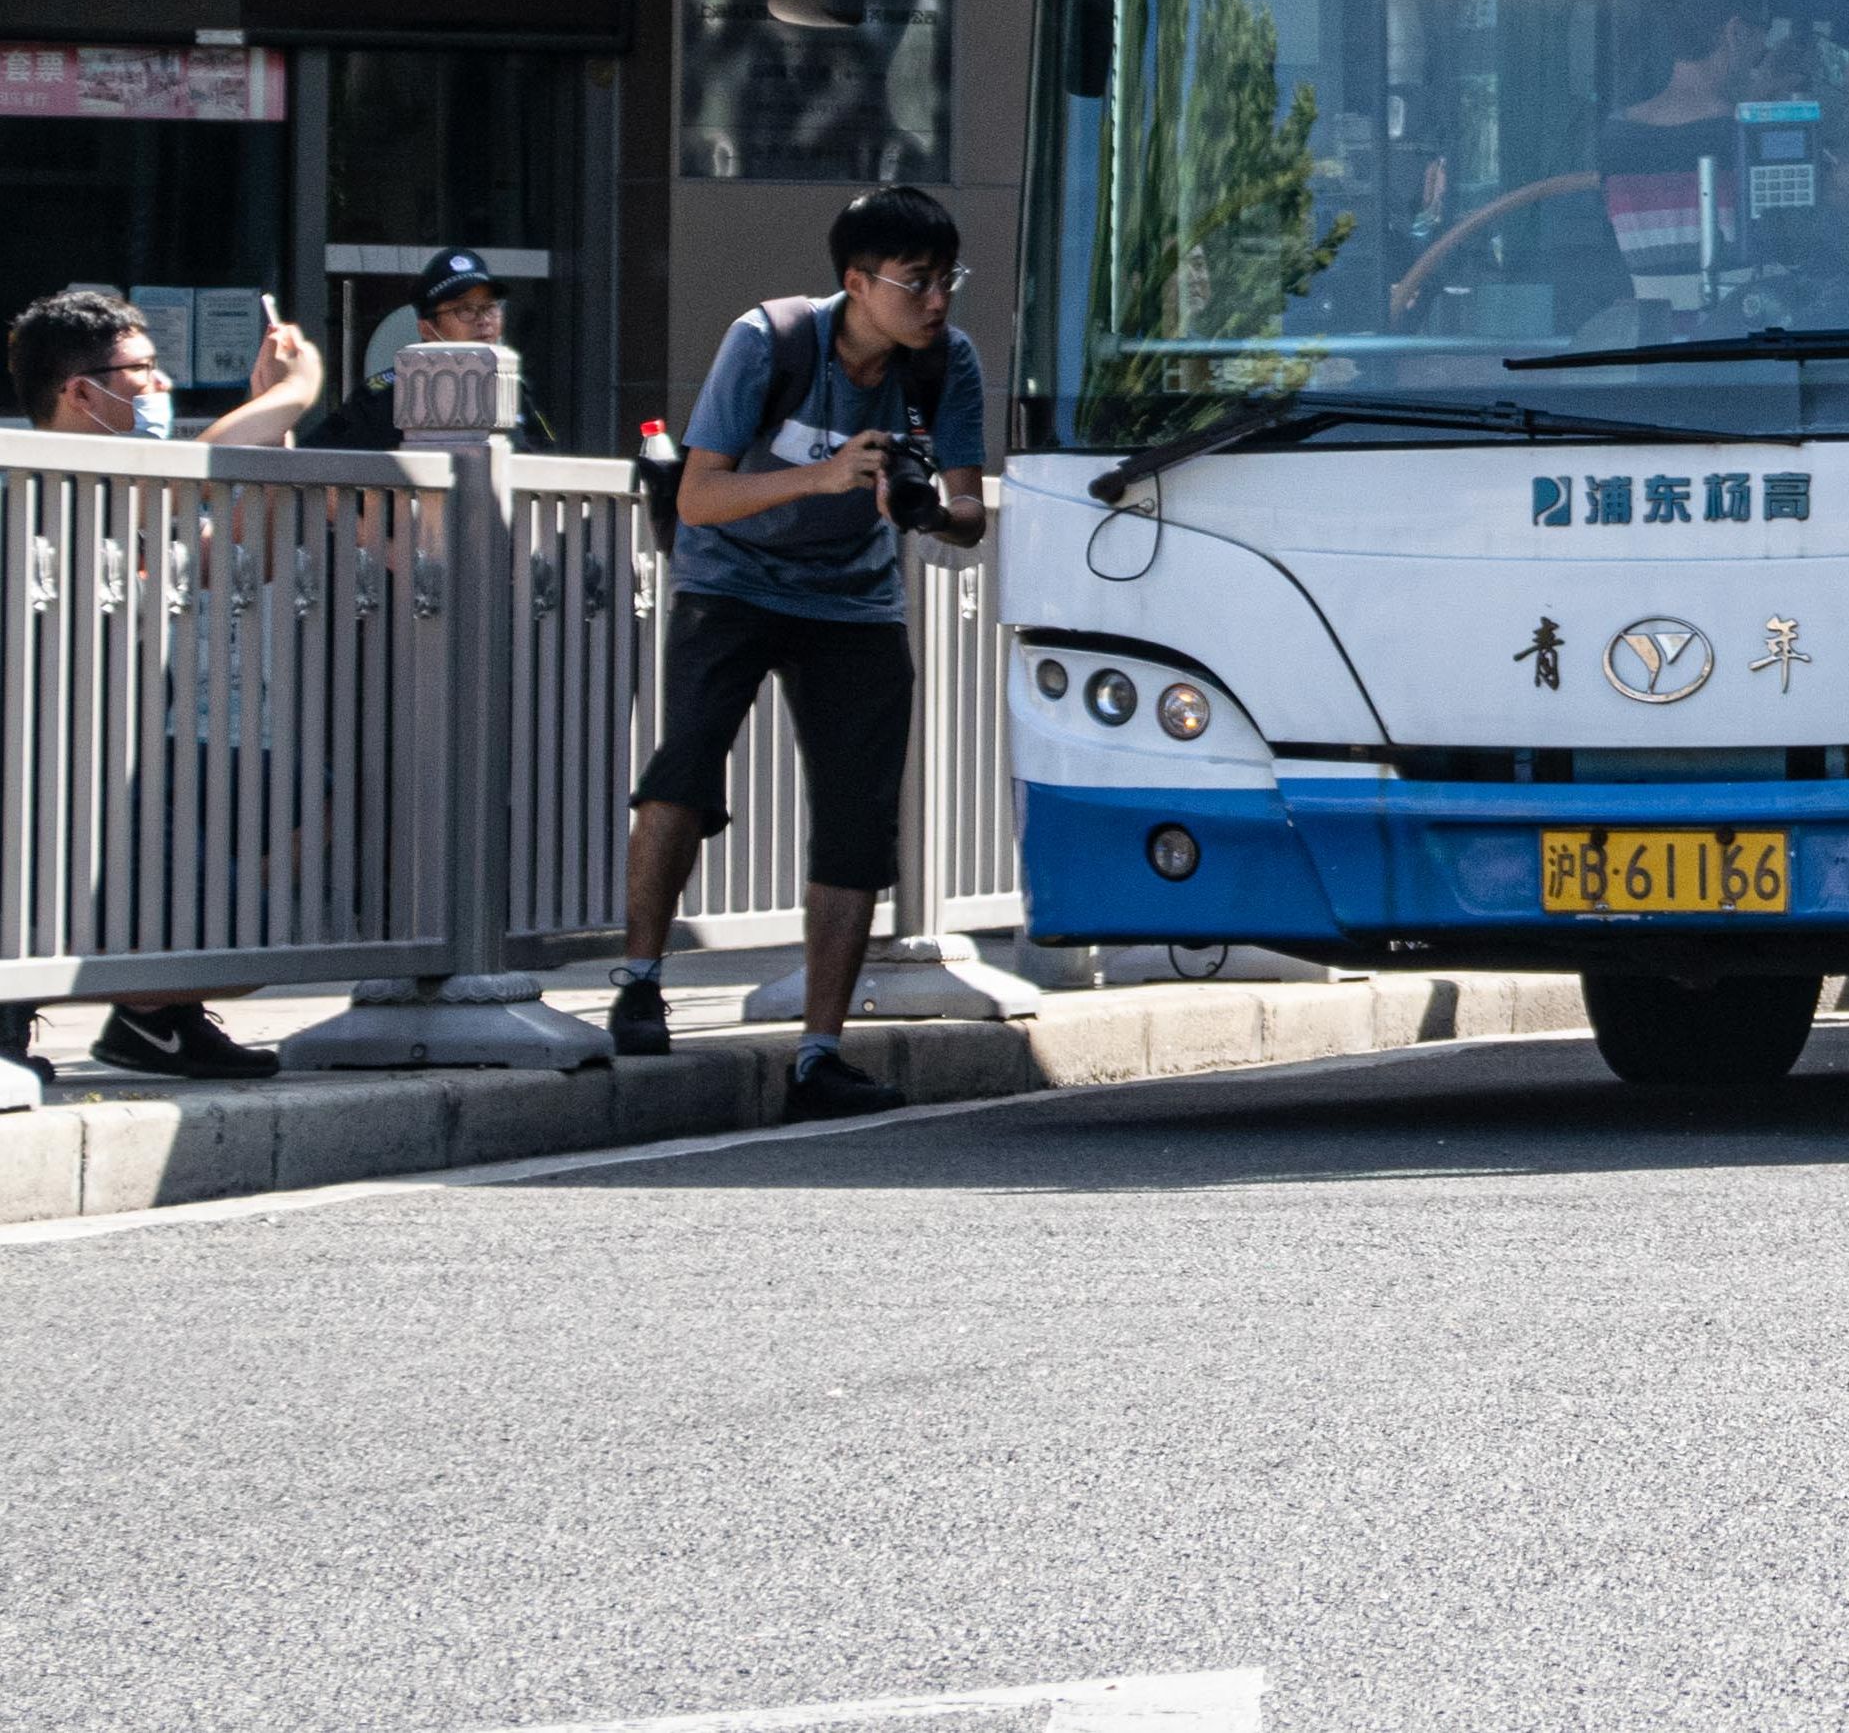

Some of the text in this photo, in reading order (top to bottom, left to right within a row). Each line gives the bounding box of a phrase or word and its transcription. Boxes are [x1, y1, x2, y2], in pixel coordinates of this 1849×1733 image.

[1585, 472, 1811, 525] 浦东杨高
[1547, 843, 1782, 902] 沪B·61166
